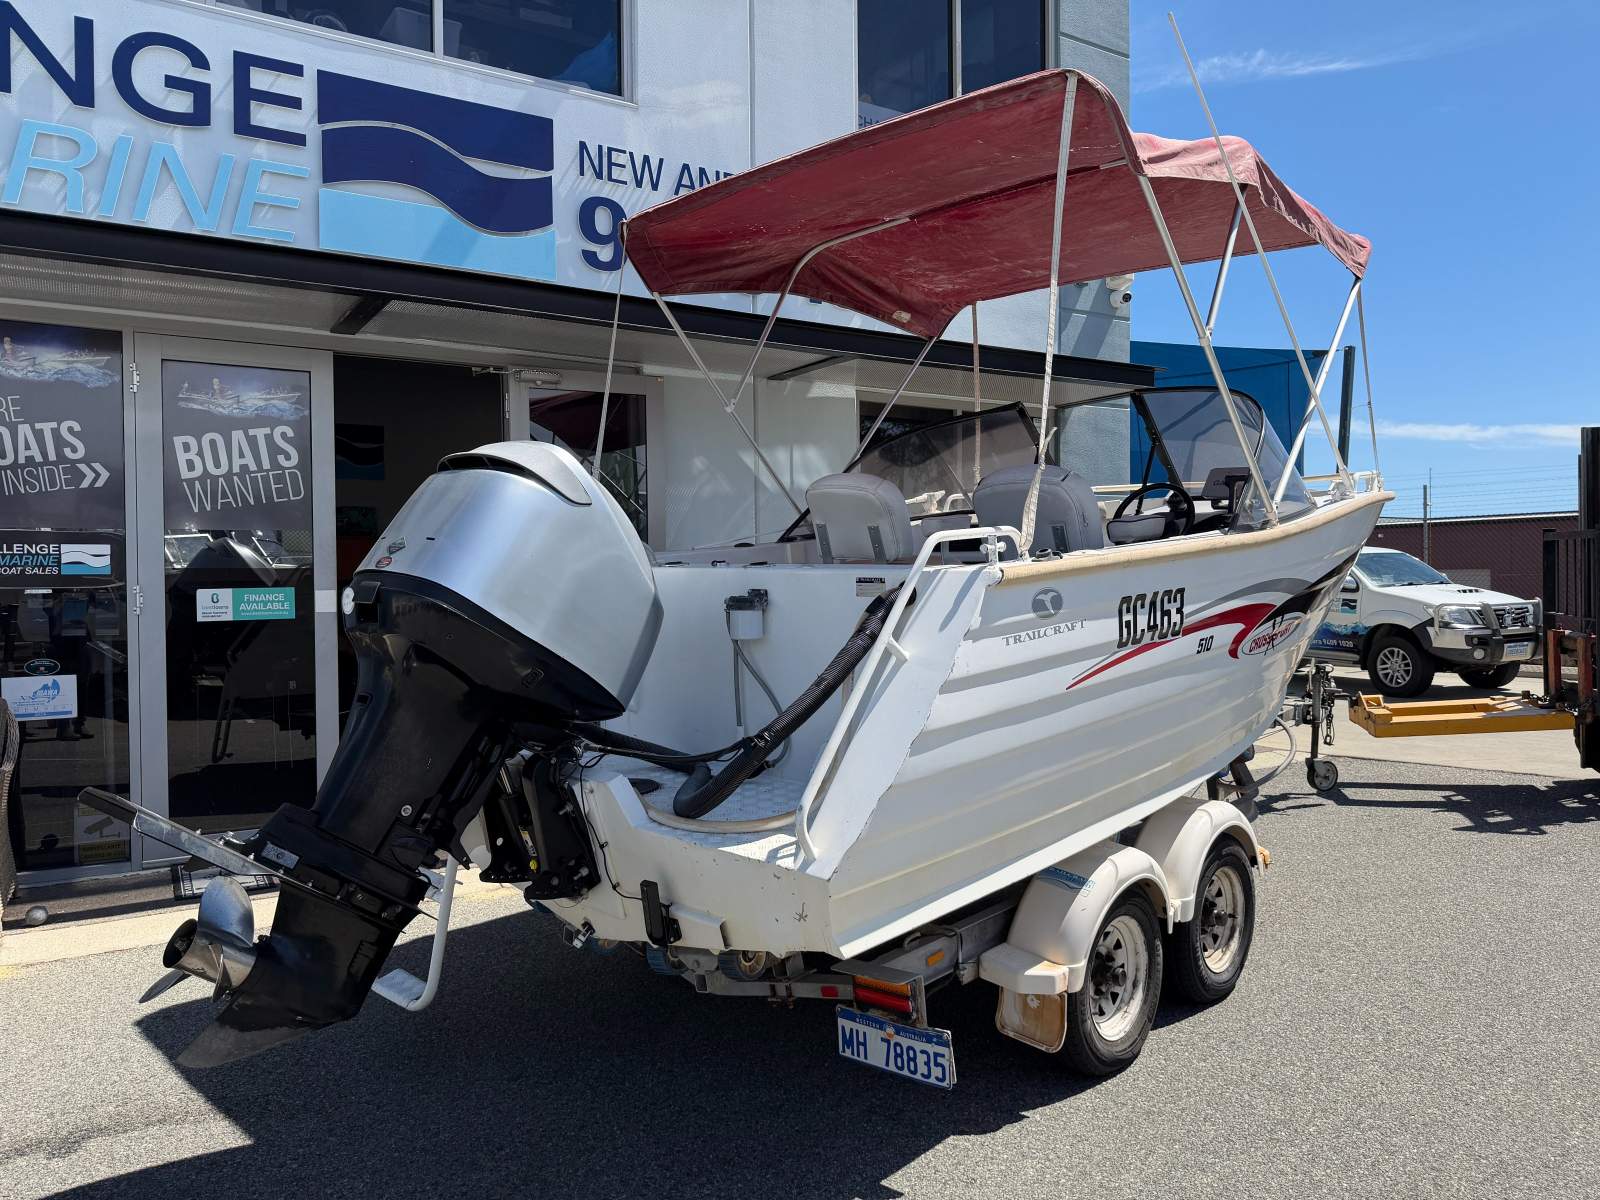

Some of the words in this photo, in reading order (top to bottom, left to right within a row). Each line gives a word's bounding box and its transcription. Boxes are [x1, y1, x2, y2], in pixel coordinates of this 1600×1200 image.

[2, 118, 311, 242] RINE
[578, 140, 664, 192] NEW
[673, 162, 735, 196] AN
[173, 425, 299, 480] BOATS
[2, 464, 76, 496] INSIDE
[182, 469, 305, 513] WANTED
[0, 555, 60, 566] MARINE
[0, 567, 23, 575] OAT
[25, 566, 59, 575] SALES
[239, 602, 290, 611] AVAILABLE
[244, 593, 285, 602] FINANCE
[1002, 618, 1088, 647] TRAILCRAFT
[1117, 587, 1186, 648] GC463
[1196, 635, 1215, 655] 510
[1339, 640, 1354, 648] 1020
[841, 1024, 868, 1060] MH
[880, 1036, 947, 1083] 78835
